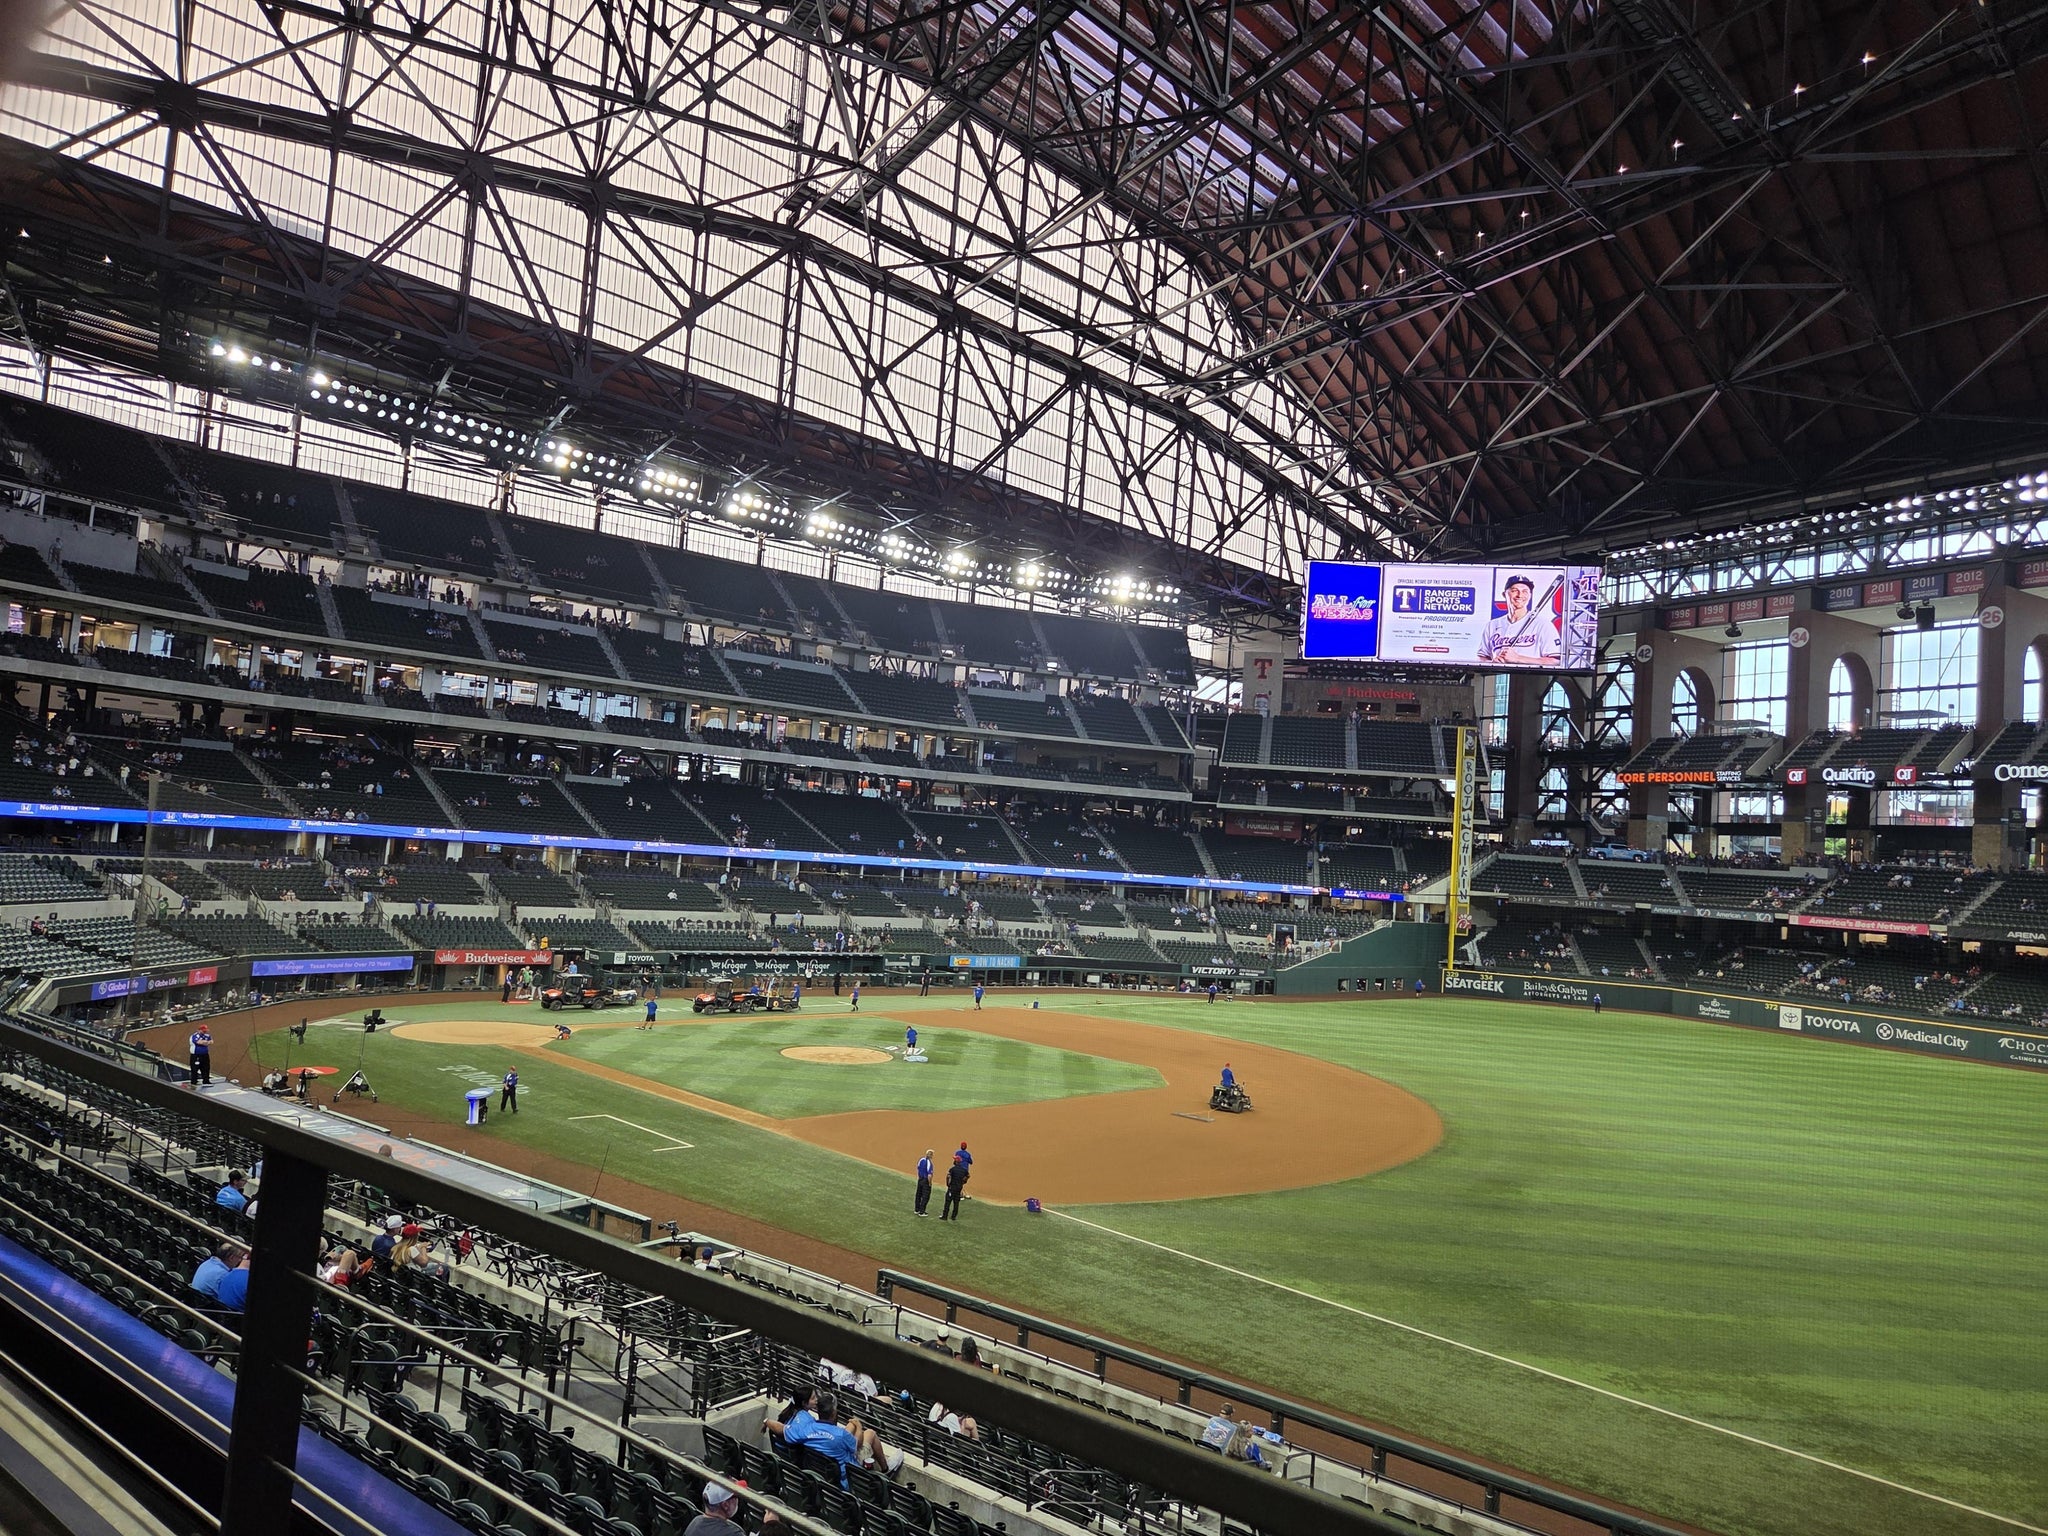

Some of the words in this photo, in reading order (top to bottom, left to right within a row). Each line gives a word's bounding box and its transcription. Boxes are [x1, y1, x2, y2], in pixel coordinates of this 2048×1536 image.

[2025, 561, 2048, 575] 201
[1912, 576, 1935, 589] 2011
[1956, 571, 1983, 583] 2012
[1424, 590, 1469, 598] RANGERS
[1829, 587, 1853, 599] 2010
[1871, 582, 1893, 594] 2011
[1312, 594, 1352, 608] ALL
[1351, 596, 1376, 609] for
[1395, 588, 1416, 610] T
[1773, 595, 1795, 607] 2010
[1704, 605, 1724, 615] 1998
[1737, 600, 1758, 611] 1999
[1312, 607, 1373, 620] TEXAS
[1671, 609, 1690, 620] 1996
[1981, 610, 2001, 624] 26
[1490, 632, 1536, 648] Rangers
[1791, 631, 1808, 643] 34
[1638, 648, 1650, 658] 42
[1254, 658, 1273, 680] T
[1346, 687, 1416, 700] Budweiser
[1616, 773, 1645, 783] CORE
[1647, 771, 1716, 783] PERSONNEL
[1788, 770, 1803, 782] QT
[1822, 768, 1876, 783] QuikTrip
[1896, 768, 1913, 780] QT
[1995, 764, 2048, 781] Come
[1653, 904, 1680, 914] American
[1716, 911, 1741, 920] American
[1809, 917, 1853, 927] America's
[1855, 920, 1875, 929] Best
[1877, 922, 1917, 932] Network
[2007, 931, 2046, 941] ARENA
[464, 953, 526, 964] Budweiser
[975, 956, 988, 967] HOW
[989, 956, 997, 967] TO
[721, 958, 748, 975] Kroger
[765, 958, 790, 974] Kroger
[1191, 966, 1233, 975] VICTORY
[108, 981, 126, 992] Globe
[155, 979, 168, 988] Globe
[168, 977, 177, 986] Life
[1445, 976, 1504, 994] SEATGEEK
[1523, 991, 1560, 999] ATTORNEYS
[1699, 1004, 1731, 1015] Budweiser
[1764, 1002, 1779, 1011] 372
[1804, 1014, 1861, 1034] TOYOTA
[1895, 1028, 1942, 1045] Medical
[1943, 1034, 1969, 1050] City
